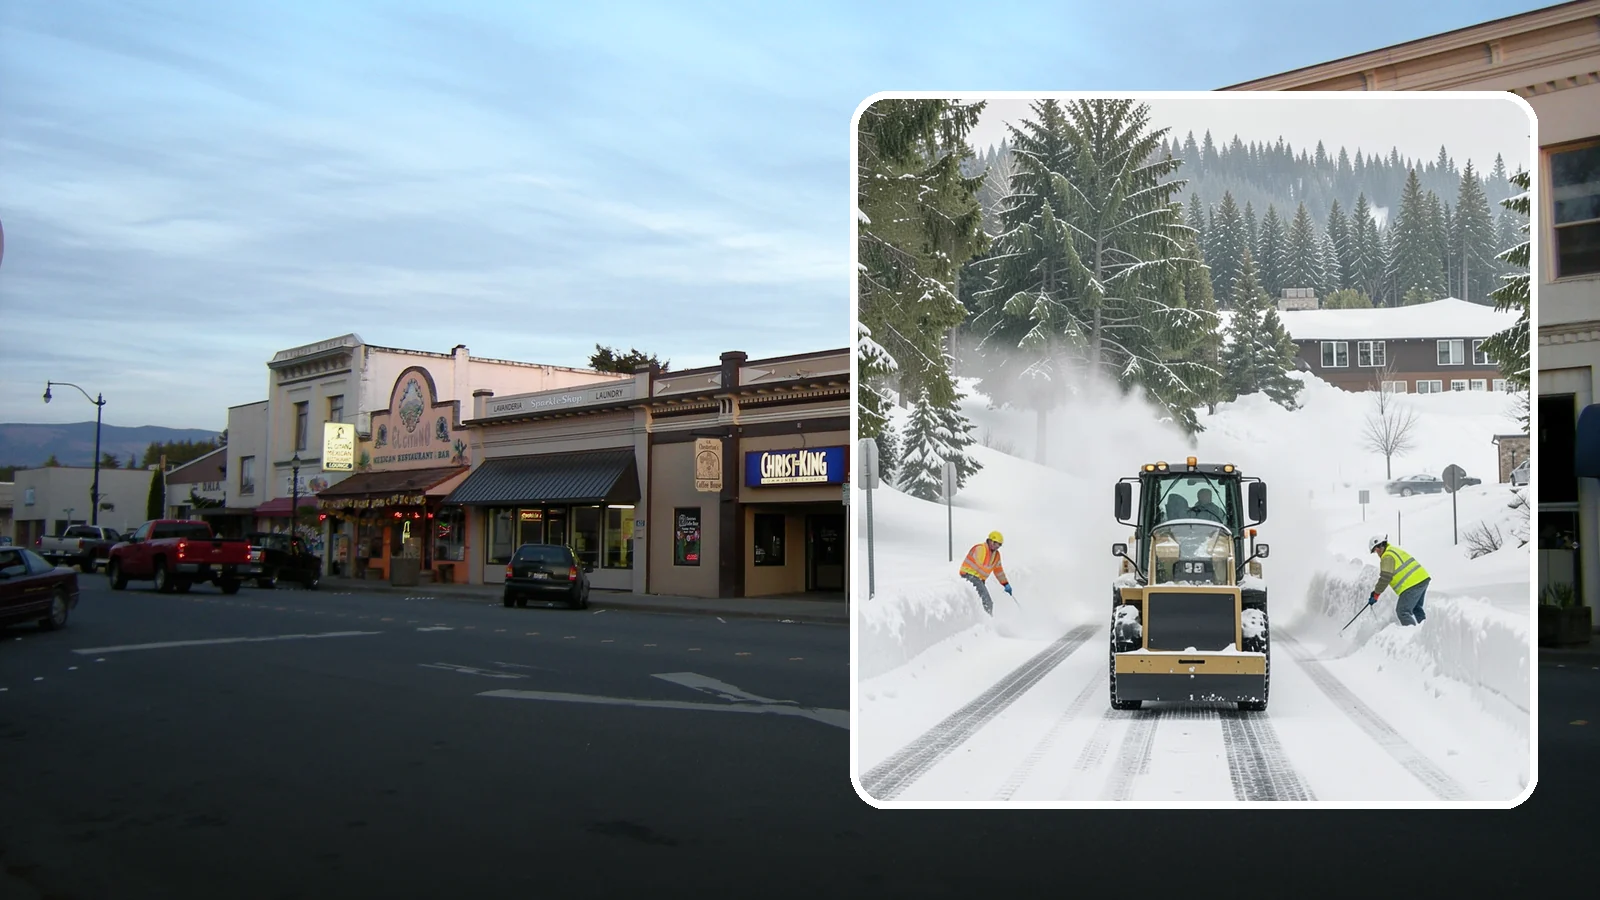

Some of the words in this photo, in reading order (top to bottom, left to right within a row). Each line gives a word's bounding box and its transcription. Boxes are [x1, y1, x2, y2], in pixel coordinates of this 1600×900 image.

[595, 389, 623, 400] LAUNDRY
[531, 398, 560, 408] Sparkle
[562, 394, 582, 406] Shop
[493, 402, 522, 413] LAVANDERIA
[373, 454, 396, 464] MEXICAN
[397, 451, 433, 462] RESTAURANT
[437, 450, 450, 459] BAR
